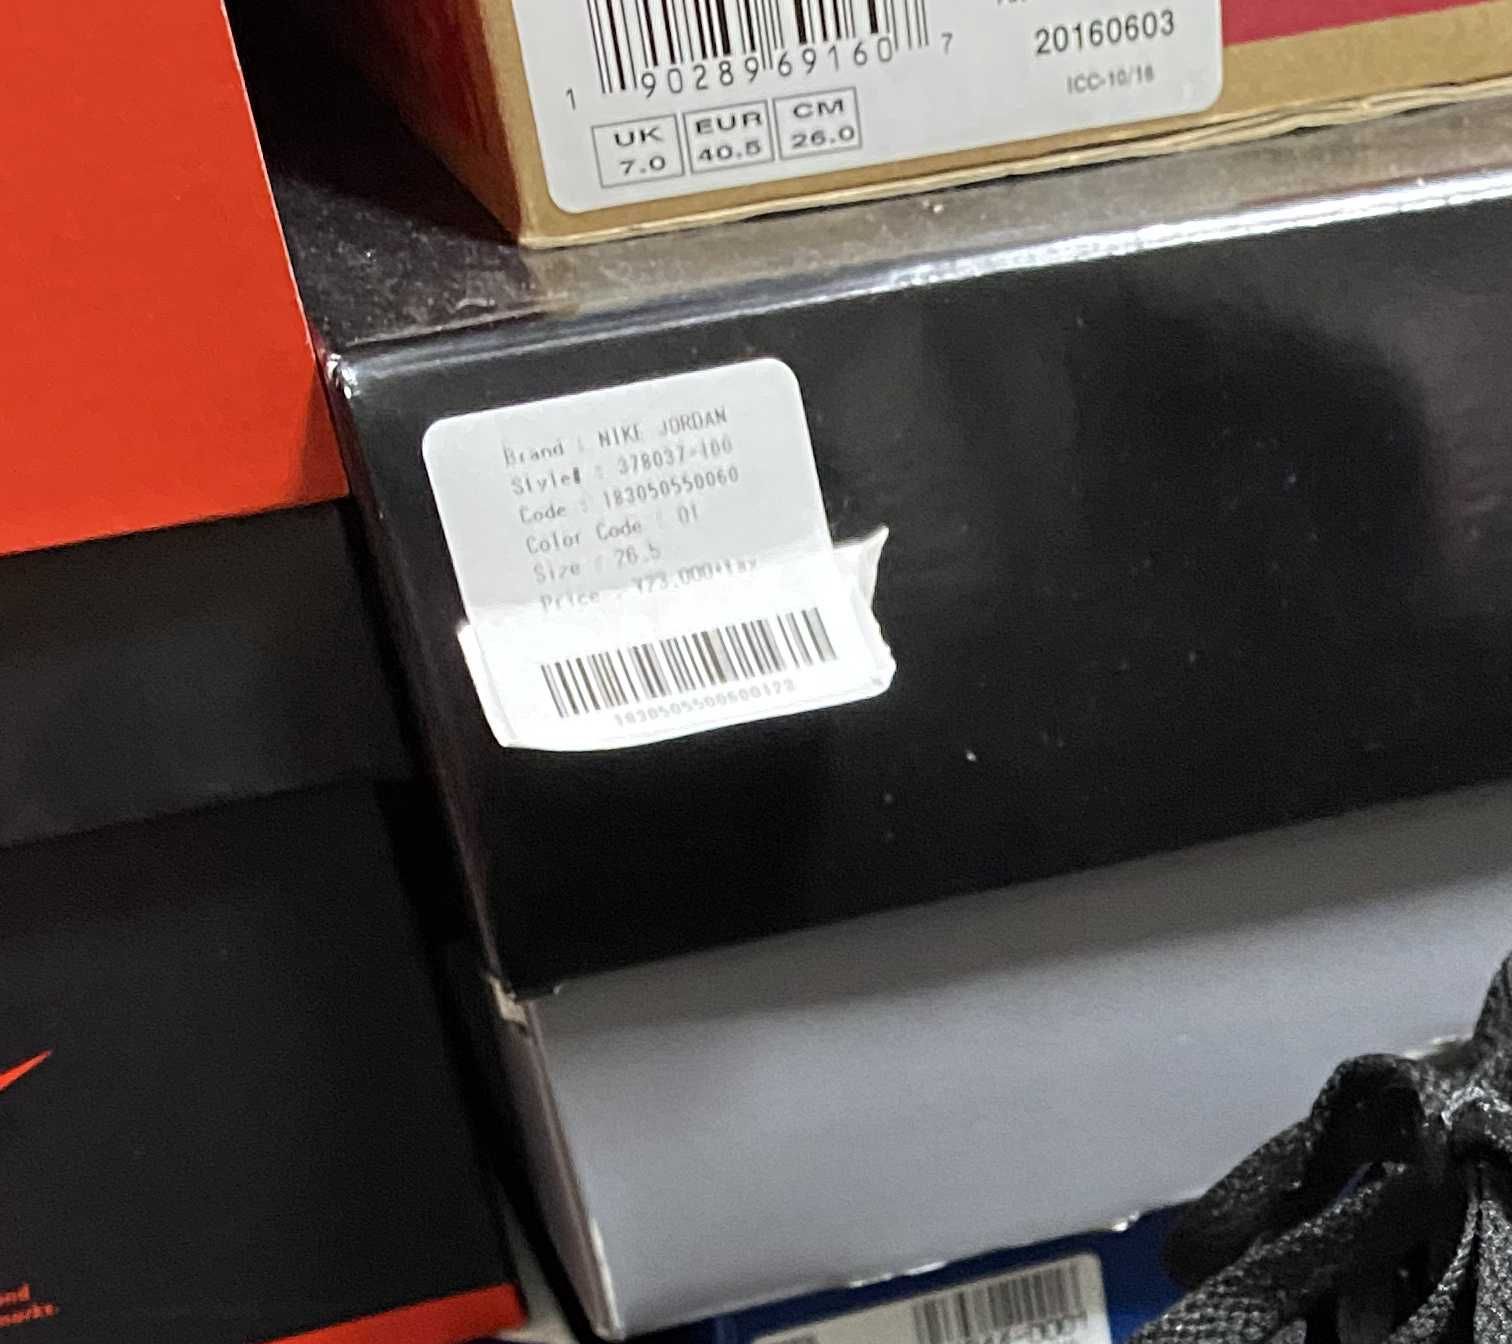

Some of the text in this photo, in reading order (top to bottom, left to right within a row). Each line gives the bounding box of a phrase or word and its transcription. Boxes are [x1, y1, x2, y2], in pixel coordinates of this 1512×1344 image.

[1035, 9, 1175, 56] 20160603
[792, 99, 844, 119] CM
[695, 111, 763, 135] EUR
[613, 127, 664, 148] UK
[791, 125, 855, 149] 26.0
[698, 140, 762, 162] 40.5
[619, 155, 666, 176] 7.0
[502, 437, 564, 467] Brand
[659, 406, 728, 437] JORDAN
[518, 503, 567, 525] Code
[526, 531, 582, 555] Color
[595, 518, 643, 541] Code
